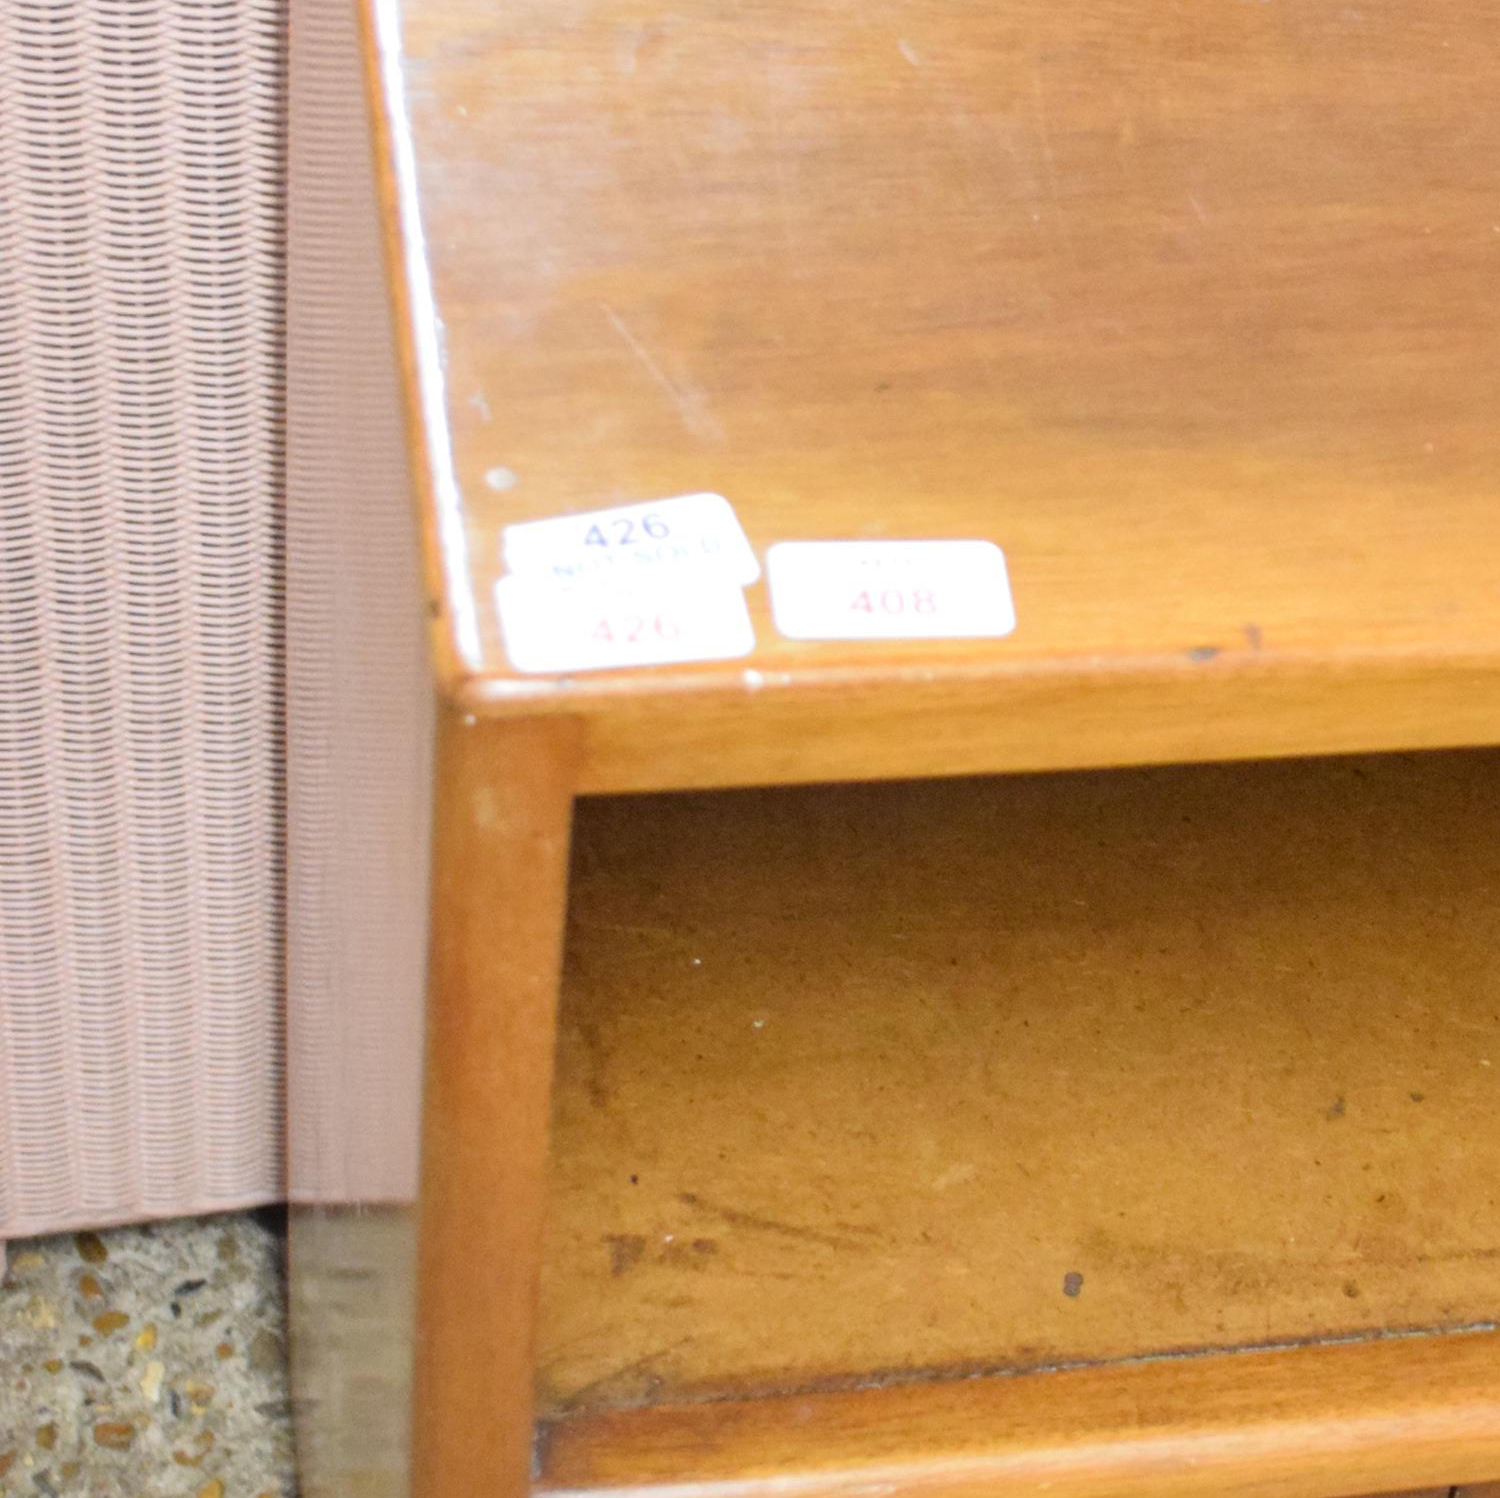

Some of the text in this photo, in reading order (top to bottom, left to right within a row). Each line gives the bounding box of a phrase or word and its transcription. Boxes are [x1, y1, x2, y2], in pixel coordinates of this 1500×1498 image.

[583, 513, 670, 548] 426
[850, 588, 937, 615] 408
[591, 614, 681, 643] 426
